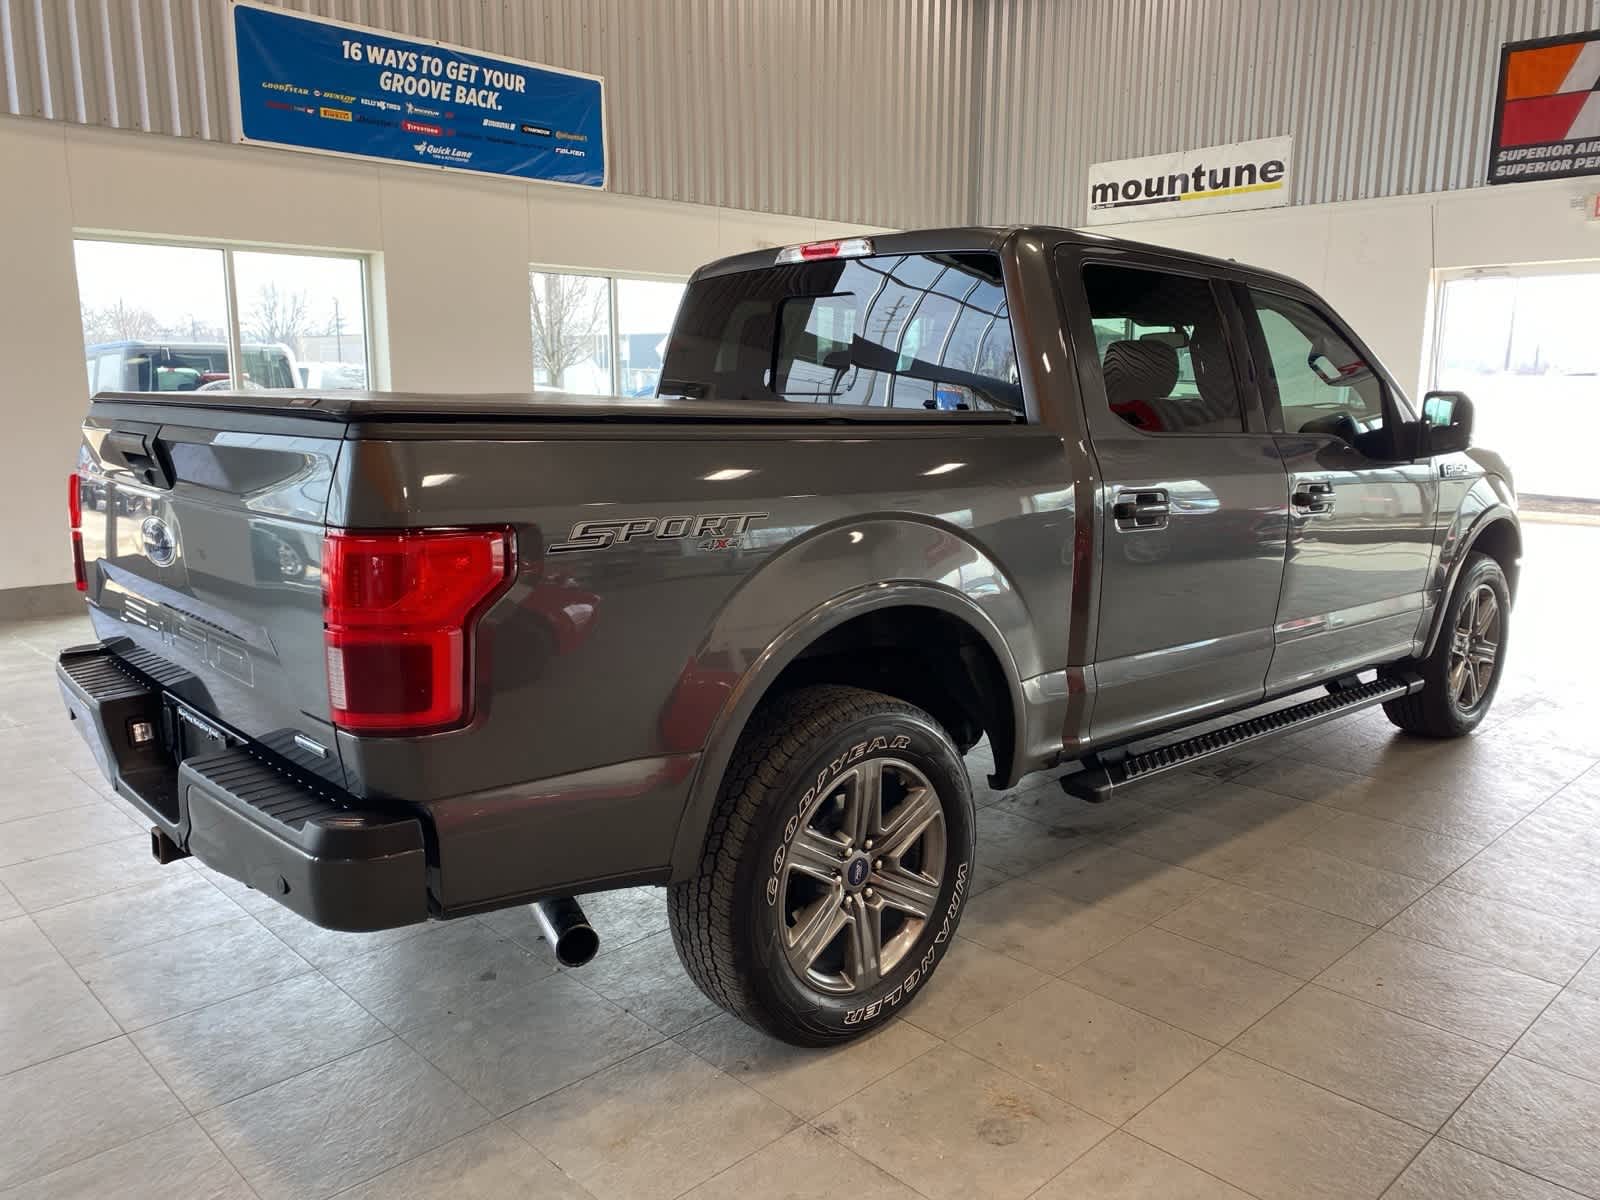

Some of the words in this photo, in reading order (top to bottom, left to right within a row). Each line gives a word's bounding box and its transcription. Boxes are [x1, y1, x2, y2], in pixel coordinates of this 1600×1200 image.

[342, 40, 362, 61] 16
[366, 44, 418, 72] WAYS
[421, 55, 443, 77] TO
[446, 60, 479, 83] GET
[482, 67, 526, 93] YOUR
[261, 81, 309, 95] GOODYEAR
[380, 71, 452, 101] GROOVE
[455, 85, 503, 111] BACK.
[426, 144, 451, 155] Quick
[451, 147, 473, 159] Lane
[1495, 159, 1573, 177] SUPERIOR
[1497, 143, 1575, 162] SUPERIOR
[1091, 159, 1285, 204] mountune
[546, 511, 770, 555] SPORT
[766, 735, 912, 906] GOODYEAR
[843, 862, 969, 1025] WRANGLER
